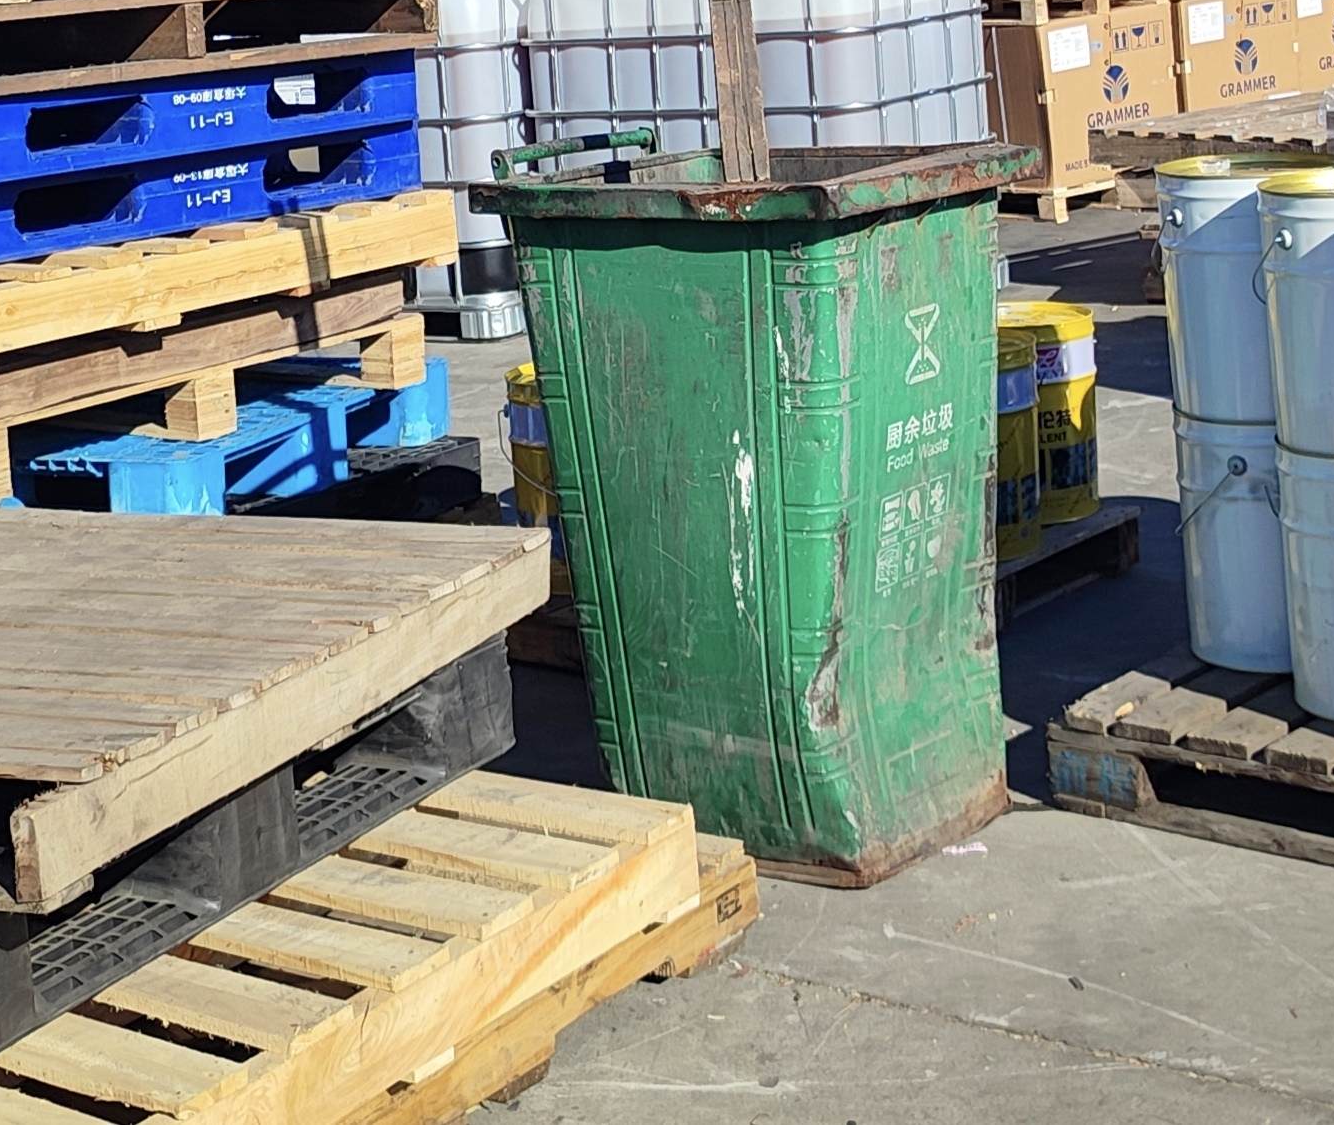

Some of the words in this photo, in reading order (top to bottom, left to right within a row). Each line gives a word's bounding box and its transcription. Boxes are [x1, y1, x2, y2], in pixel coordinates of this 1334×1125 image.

[1220, 75, 1276, 98] GRAMMER
[190, 111, 233, 130] EJ-11
[1087, 103, 1150, 128] GRAMMER
[1066, 161, 1082, 172] MADE
[187, 188, 231, 208] EJ-11
[886, 403, 953, 452] 厨余垃圾
[887, 448, 914, 473] Food
[918, 437, 950, 461] Waste
